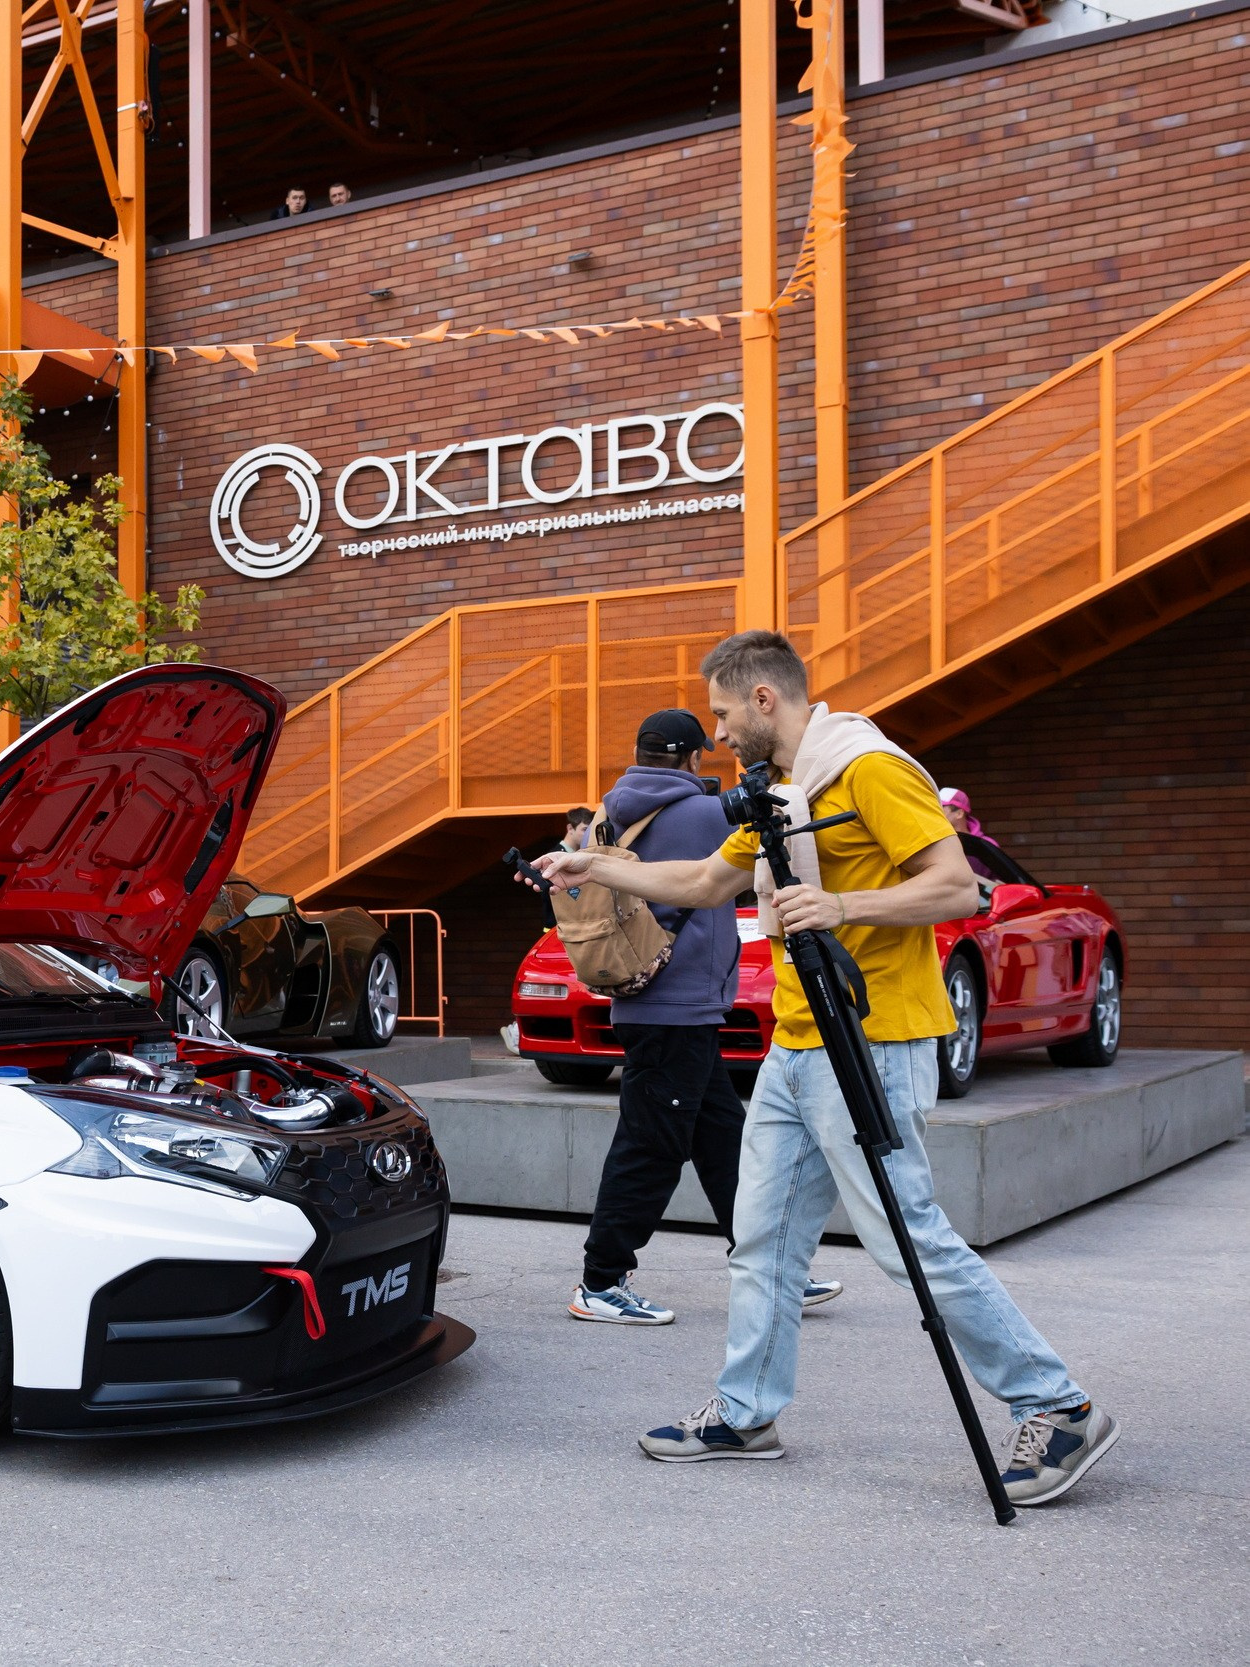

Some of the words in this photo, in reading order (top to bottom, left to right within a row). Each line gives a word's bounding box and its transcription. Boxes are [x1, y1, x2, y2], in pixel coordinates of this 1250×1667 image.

[338, 524, 458, 559] творческий
[465, 500, 650, 542] индустриальный
[341, 1261, 411, 1317] TMS
